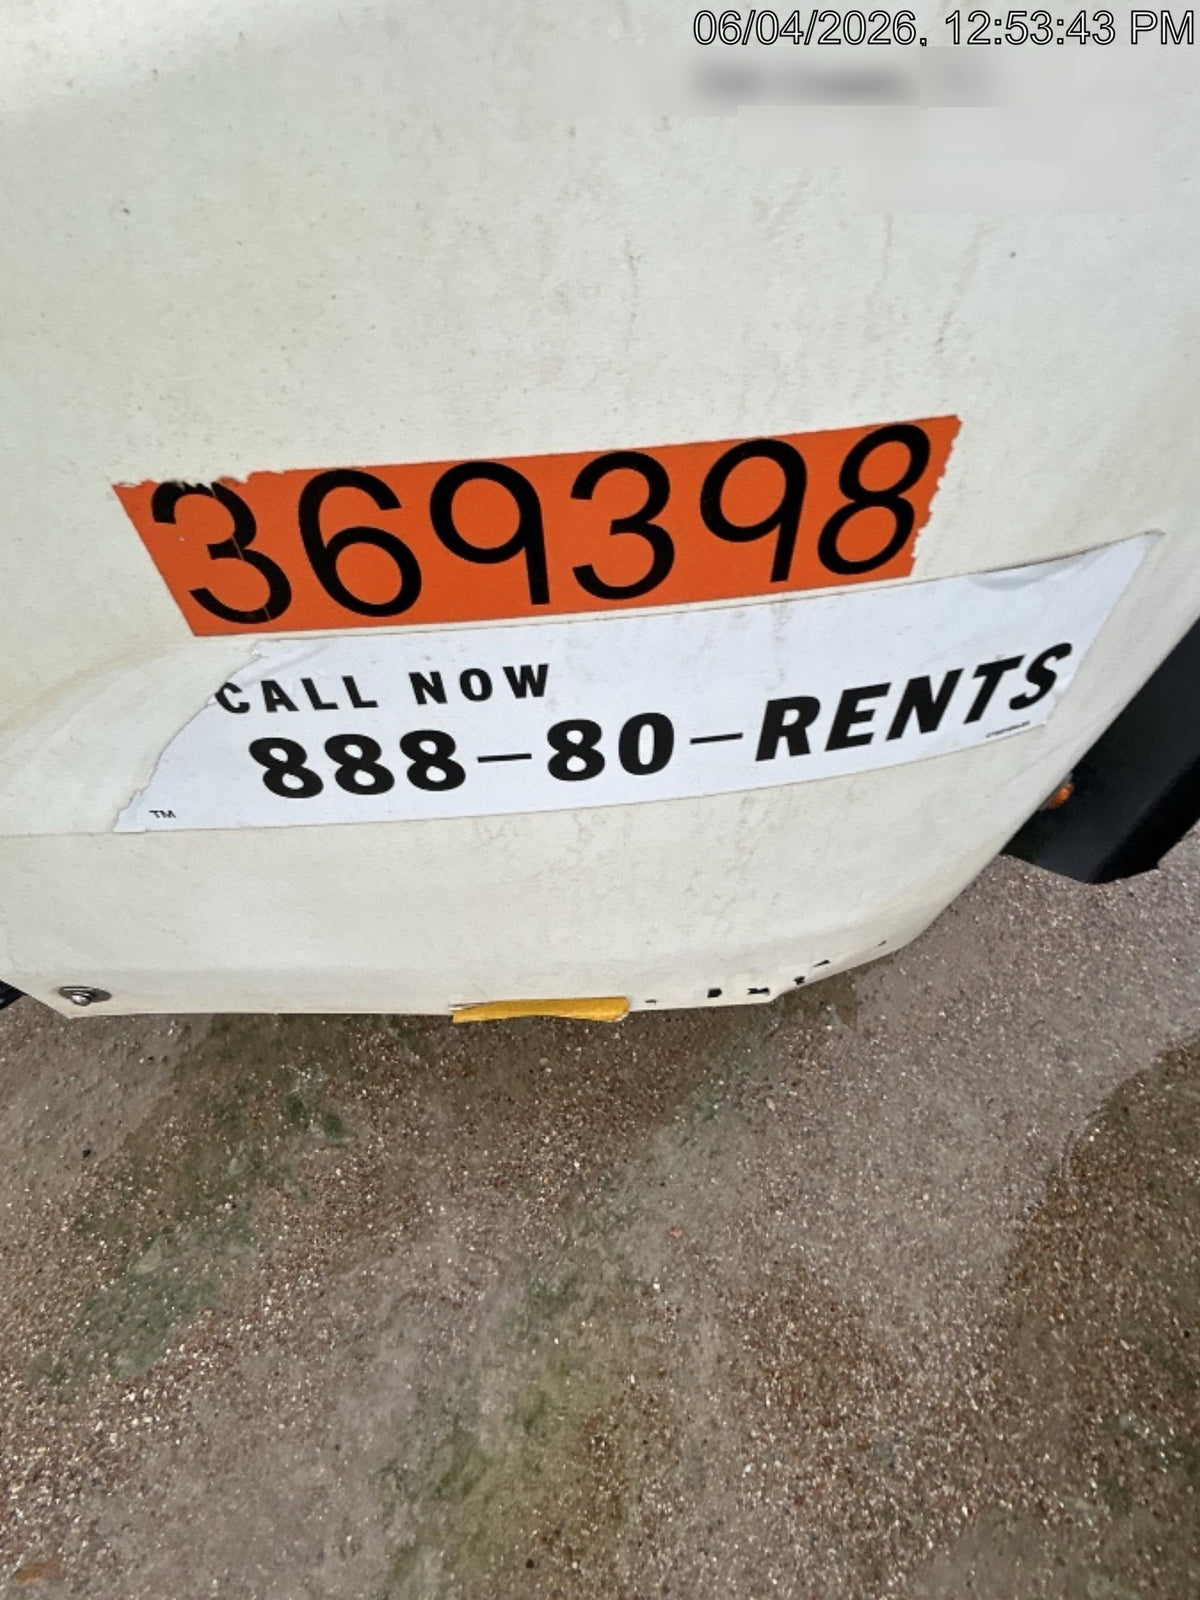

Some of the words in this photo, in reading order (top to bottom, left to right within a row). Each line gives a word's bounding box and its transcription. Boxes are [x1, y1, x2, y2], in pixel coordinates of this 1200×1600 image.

[151, 423, 931, 625] 369398
[214, 675, 379, 715] CALL
[408, 663, 549, 705] NOW
